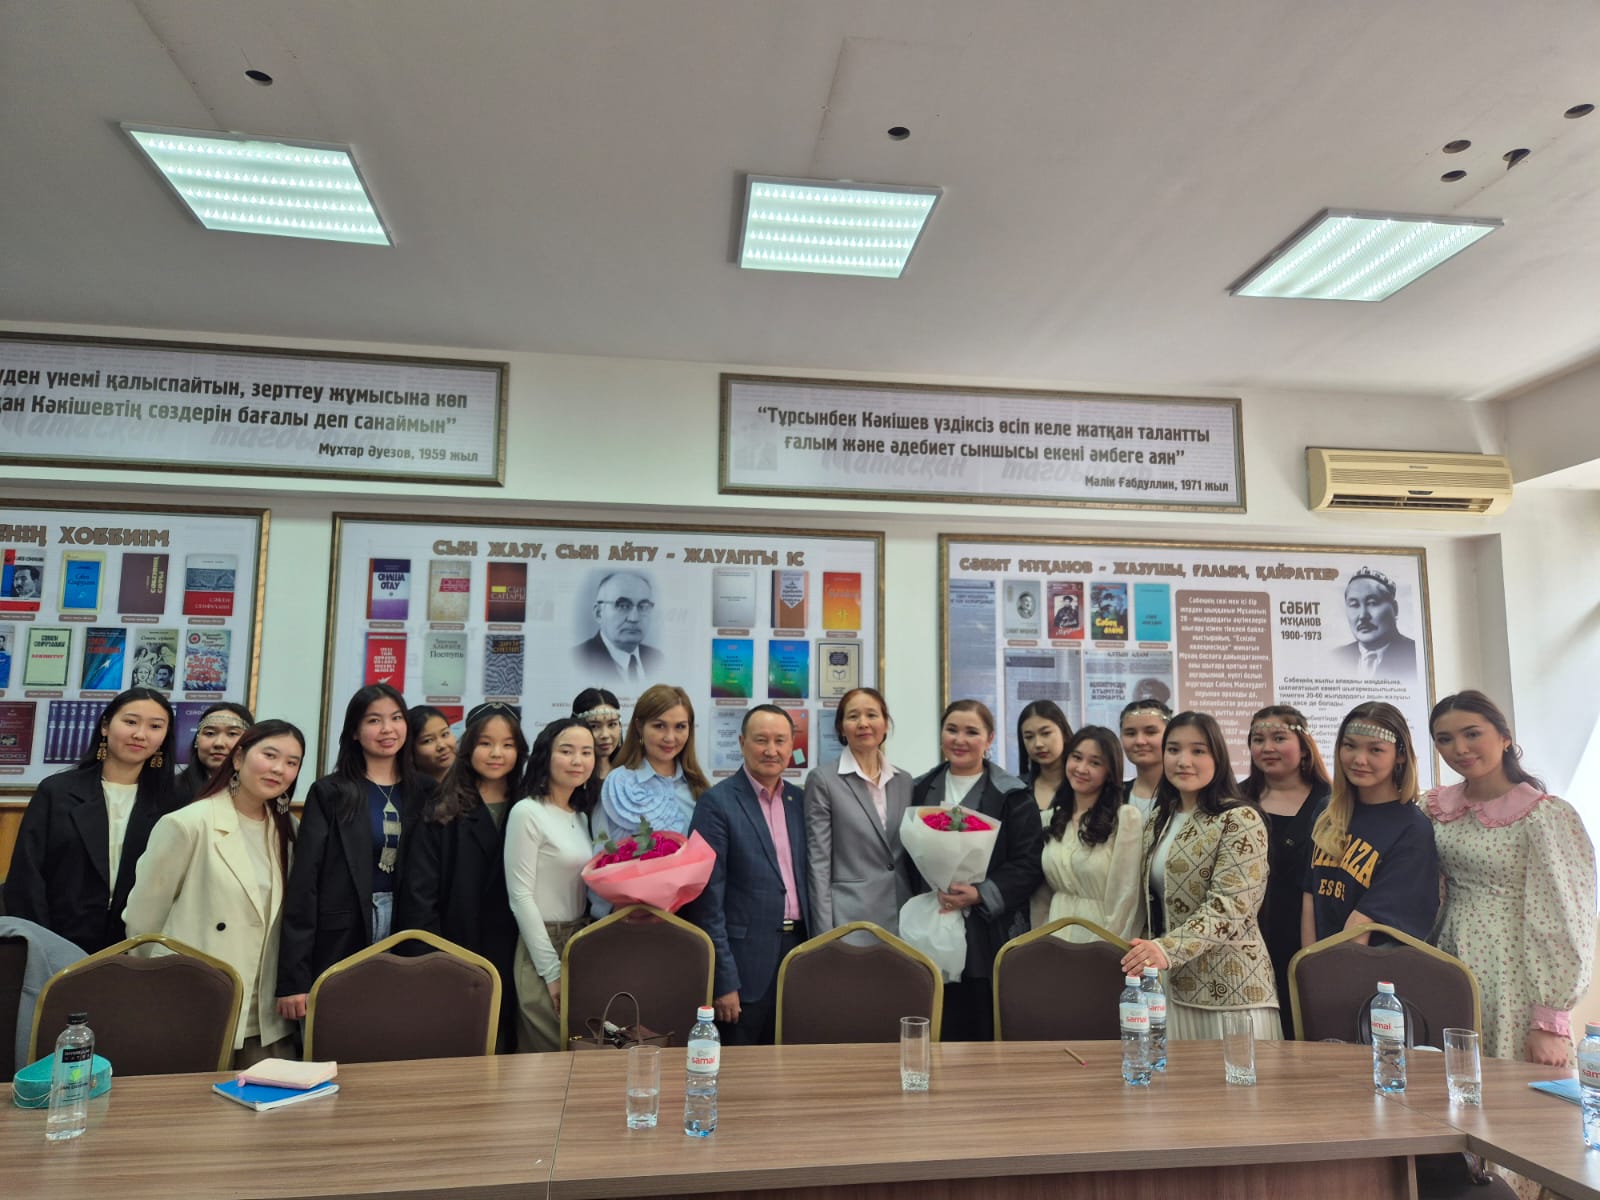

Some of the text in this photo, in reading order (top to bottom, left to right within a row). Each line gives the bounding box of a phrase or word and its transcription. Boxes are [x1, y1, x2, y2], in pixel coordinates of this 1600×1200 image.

[47, 370, 100, 389] үнемі
[106, 373, 244, 399] қалыспайтын,
[251, 382, 324, 404] зерттеу
[329, 386, 430, 406] жұмысына
[436, 392, 468, 409] көп
[0, 396, 25, 413] ан
[31, 395, 142, 420] Кәкішевтің
[148, 403, 232, 425] сөздерін
[238, 407, 308, 427] бағалы
[314, 414, 348, 431] деп
[862, 411, 929, 431] Кәкішев
[934, 415, 995, 434] үздіксіз
[999, 418, 1030, 435] өсіп
[1034, 422, 1072, 437] келе
[1077, 424, 1133, 442] жатқан
[1138, 427, 1210, 443] талантты
[318, 442, 479, 463] Мұхтар Әуезов, 1959 жыл
[784, 435, 837, 451] ғалым
[843, 438, 885, 454] және
[890, 440, 955, 457] әдебиет
[960, 443, 1039, 460] сыншысы
[1043, 445, 1084, 462] екені
[1090, 447, 1144, 464] әмбеге
[1180, 480, 1202, 492] 1971
[1204, 482, 1229, 493] жыл
[58, 526, 170, 547] ХОББИІМ
[432, 539, 478, 557] СЫН
[487, 540, 548, 561] ЖАЗУ,
[555, 543, 600, 560] СЫН
[606, 541, 659, 562] АЙТУ
[683, 547, 779, 566] ЖАУАПТЫ
[786, 551, 805, 567] ІС
[959, 557, 1012, 574] СӘБИТ
[1018, 559, 1093, 576] МҰҚАНОВ
[1112, 561, 1187, 578] ЖАЗУШЫ,
[1256, 563, 1339, 582] ҚАЙРАТКЕР
[1279, 600, 1321, 616] СӘБИТ
[1280, 616, 1322, 627] МҰҚАНОВ
[1280, 630, 1322, 641] 1900-1973
[61, 708, 67, 716] 2
[71, 708, 76, 716] 3
[81, 708, 86, 716] 4
